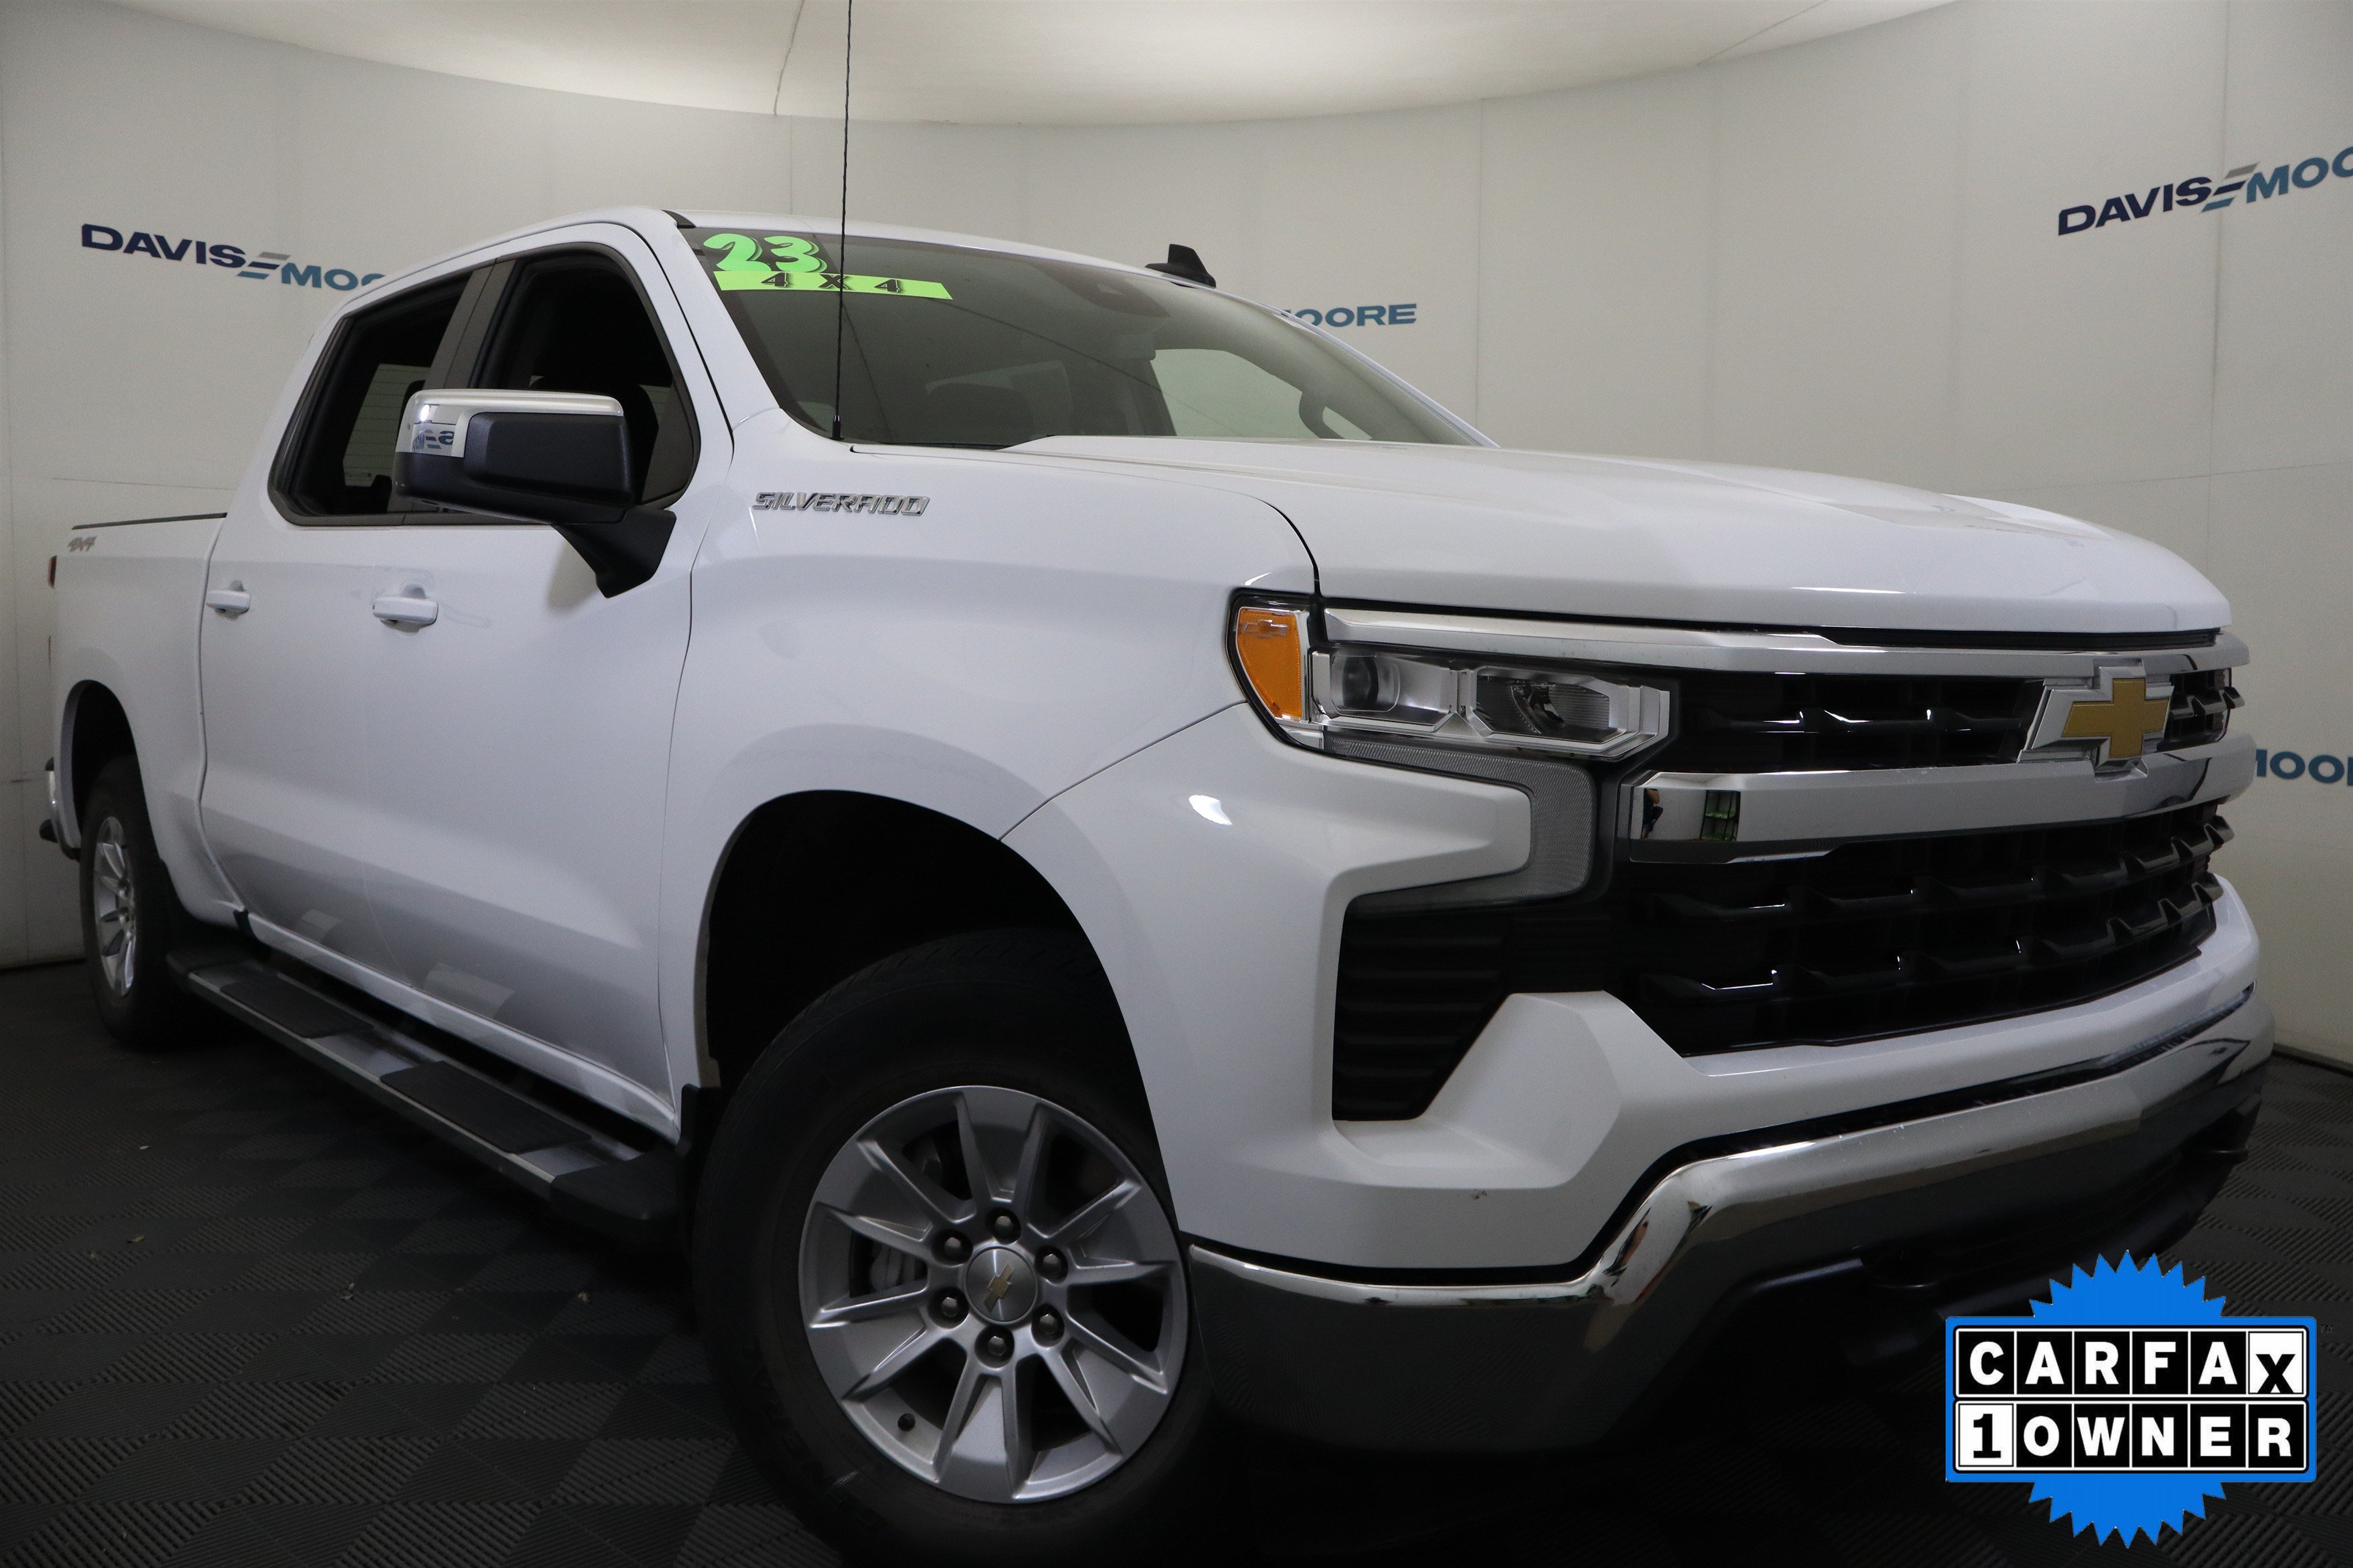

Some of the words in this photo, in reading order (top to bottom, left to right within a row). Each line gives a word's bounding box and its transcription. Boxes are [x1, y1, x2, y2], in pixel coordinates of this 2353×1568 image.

[2058, 176, 2212, 235] DAVIS
[81, 223, 246, 268] DAVIS
[703, 233, 827, 273] 23
[1281, 303, 1417, 327] OORE
[753, 492, 930, 516] SILVERADO
[2256, 748, 2353, 786] OO
